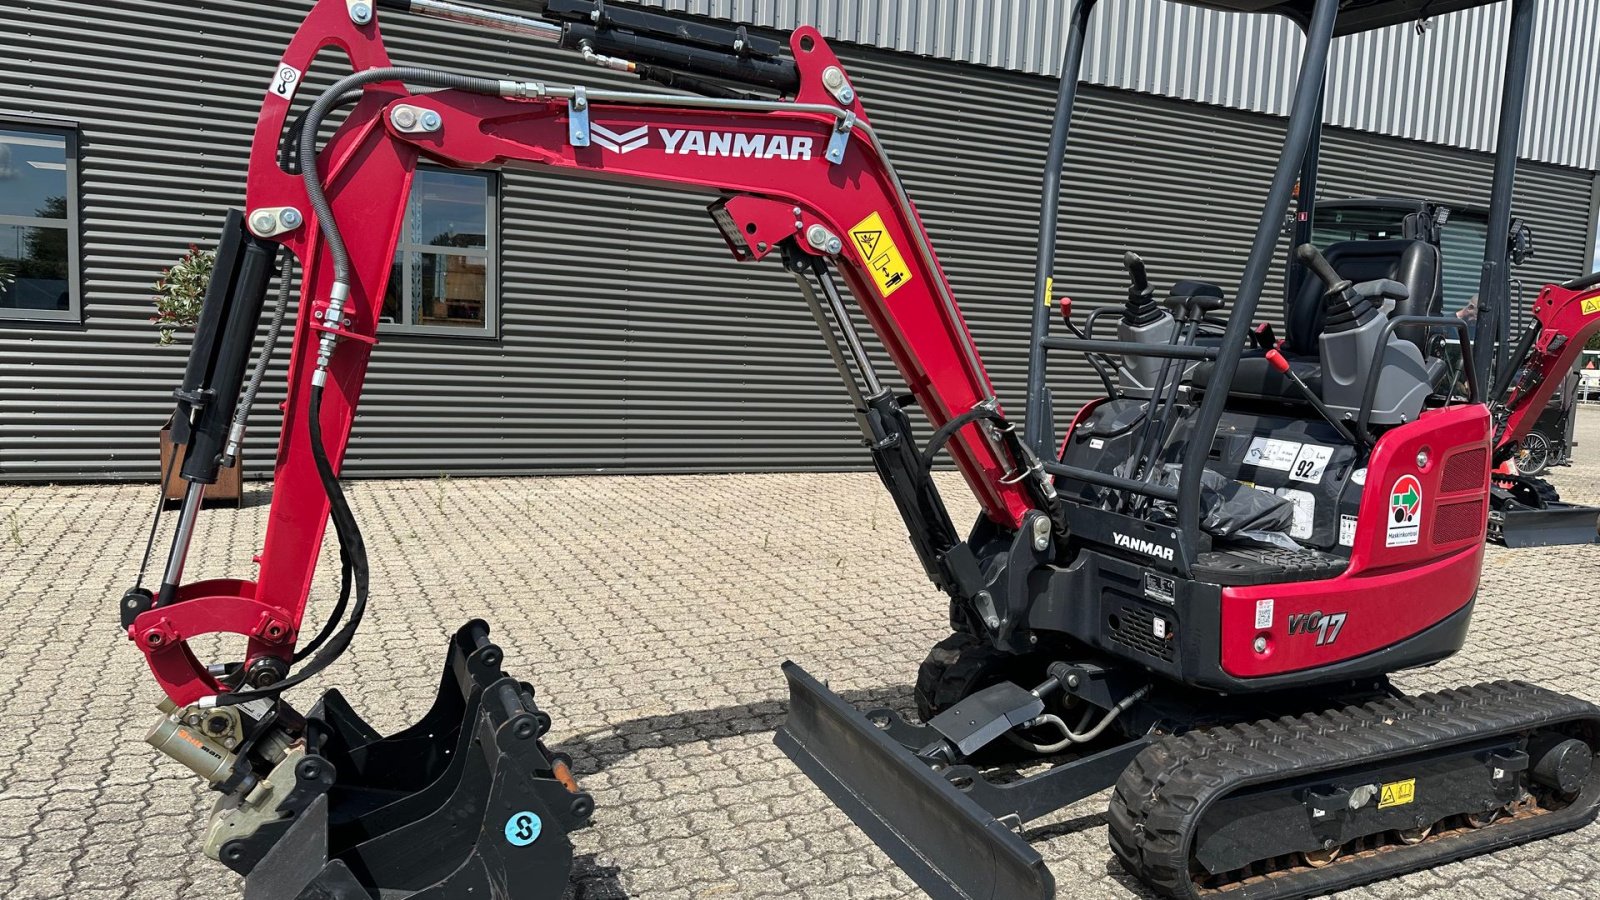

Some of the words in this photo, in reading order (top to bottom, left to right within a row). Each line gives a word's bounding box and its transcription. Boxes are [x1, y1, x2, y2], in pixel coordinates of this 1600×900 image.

[658, 128, 813, 161] YANMAR
[1295, 459, 1314, 479] 92
[1112, 531, 1174, 561] YANMAR
